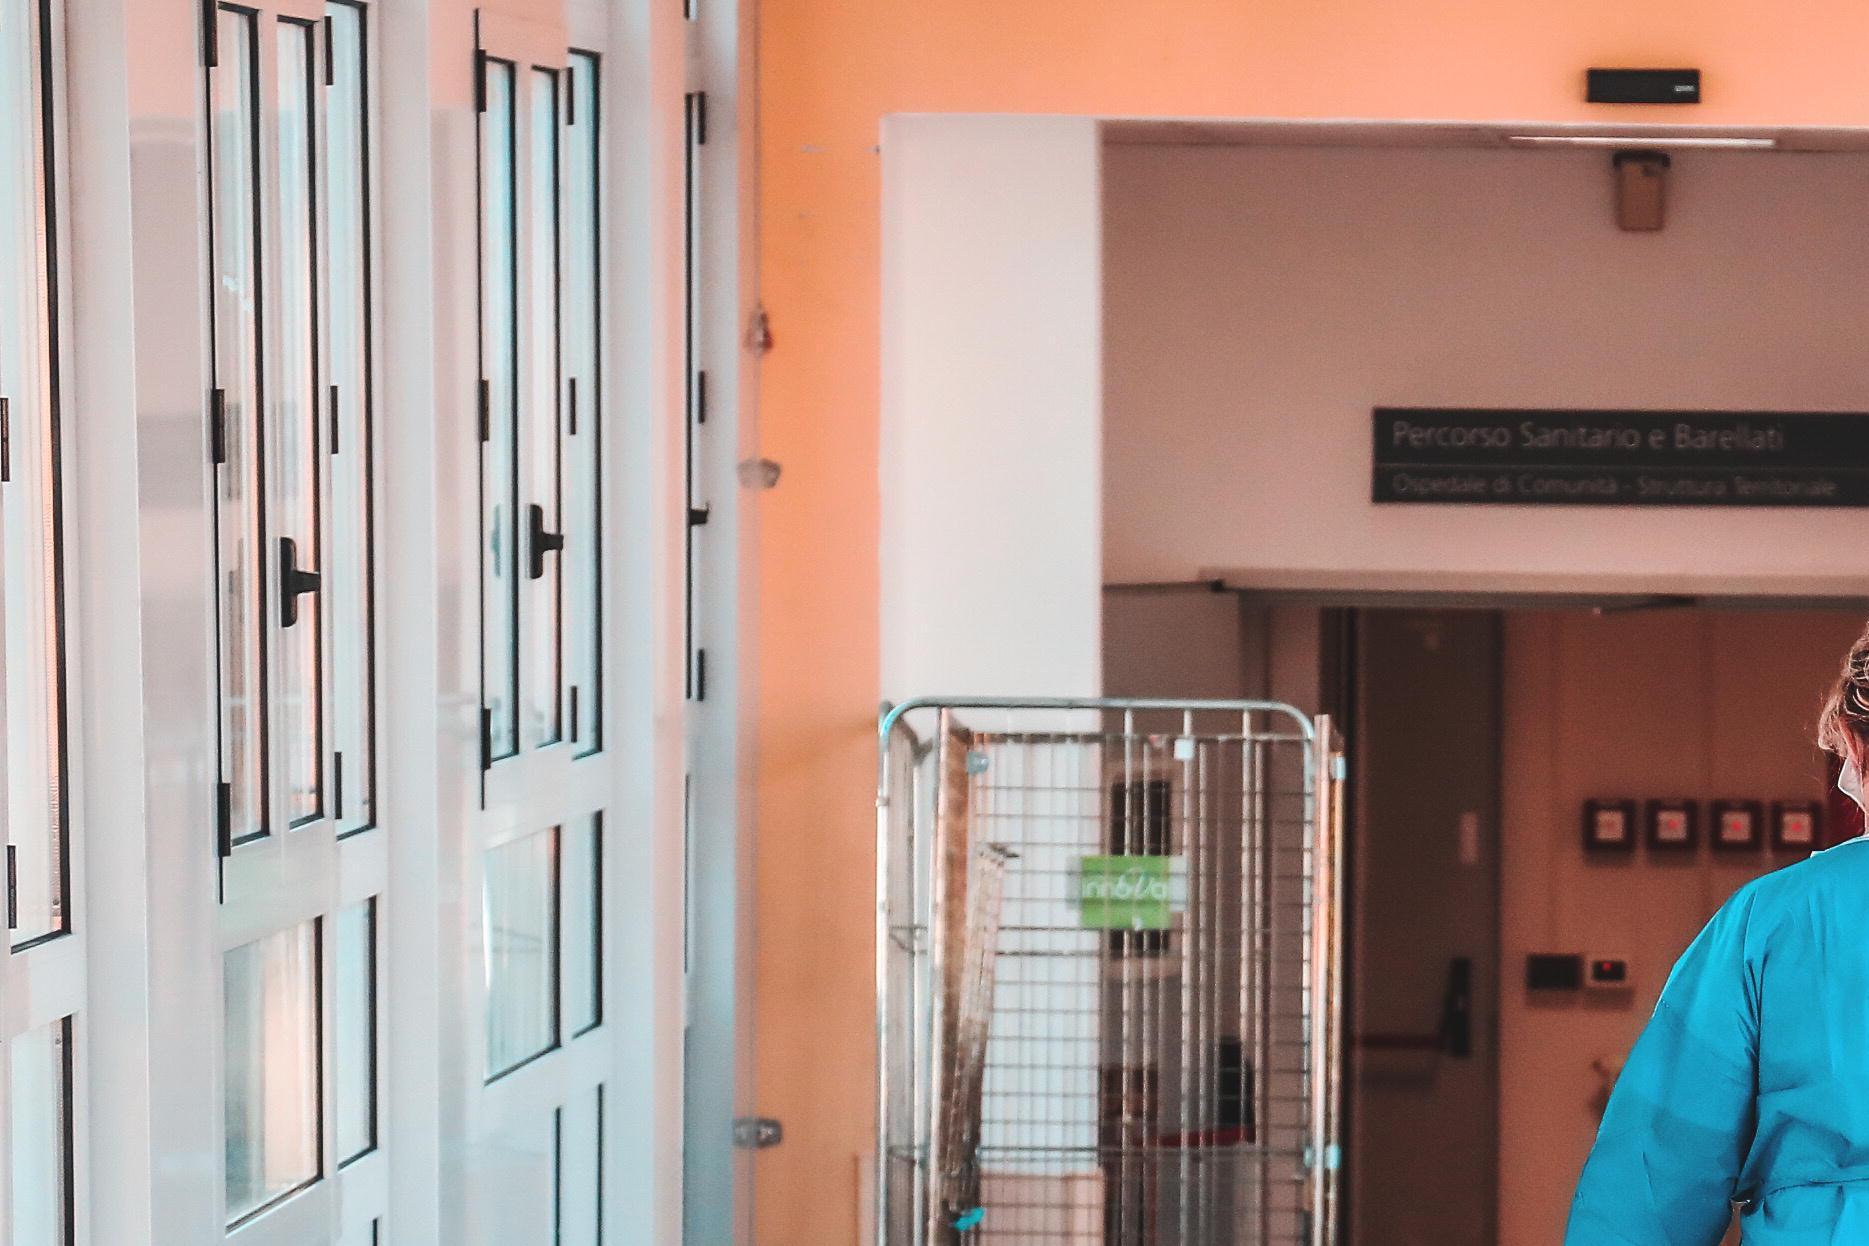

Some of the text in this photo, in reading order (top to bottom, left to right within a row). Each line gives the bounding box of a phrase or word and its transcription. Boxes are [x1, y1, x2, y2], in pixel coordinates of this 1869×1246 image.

[1392, 421, 1511, 449] Percorso
[1520, 421, 1640, 449] Sanitario
[1648, 427, 1666, 450] e
